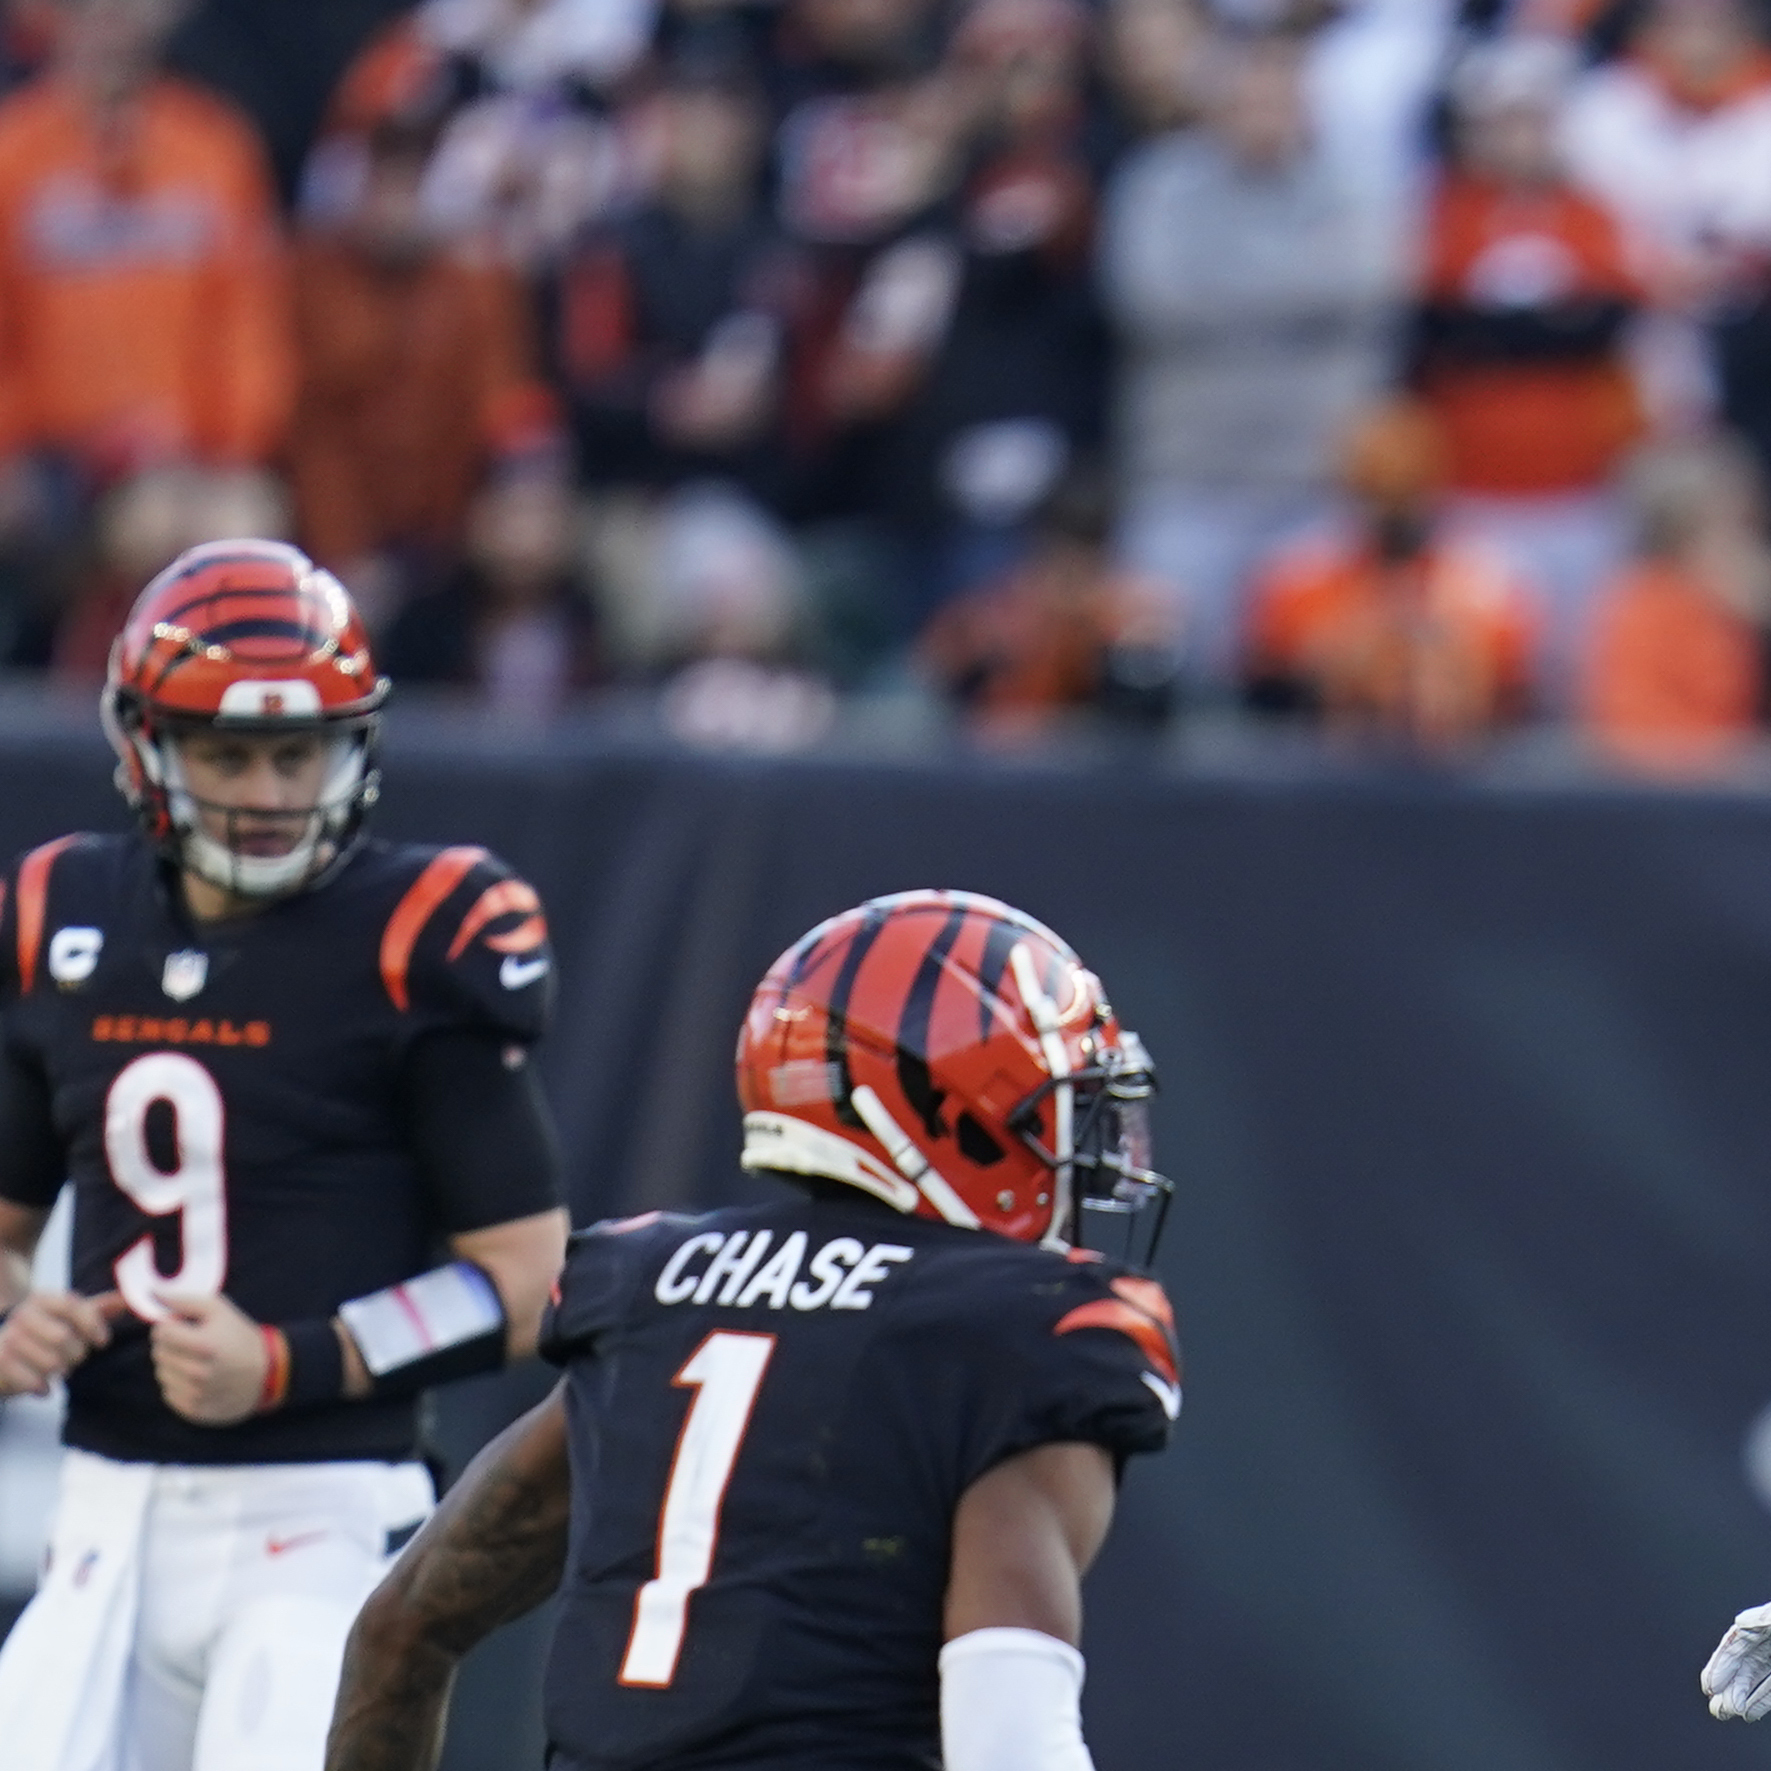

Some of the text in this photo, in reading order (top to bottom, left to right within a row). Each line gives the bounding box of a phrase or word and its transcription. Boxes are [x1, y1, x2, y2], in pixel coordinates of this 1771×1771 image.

[49, 926, 104, 982] C
[92, 1014, 271, 1047] BENGALS
[103, 1049, 228, 1326] 9
[655, 1229, 914, 1311] CHASE
[617, 1327, 778, 1690] 1
